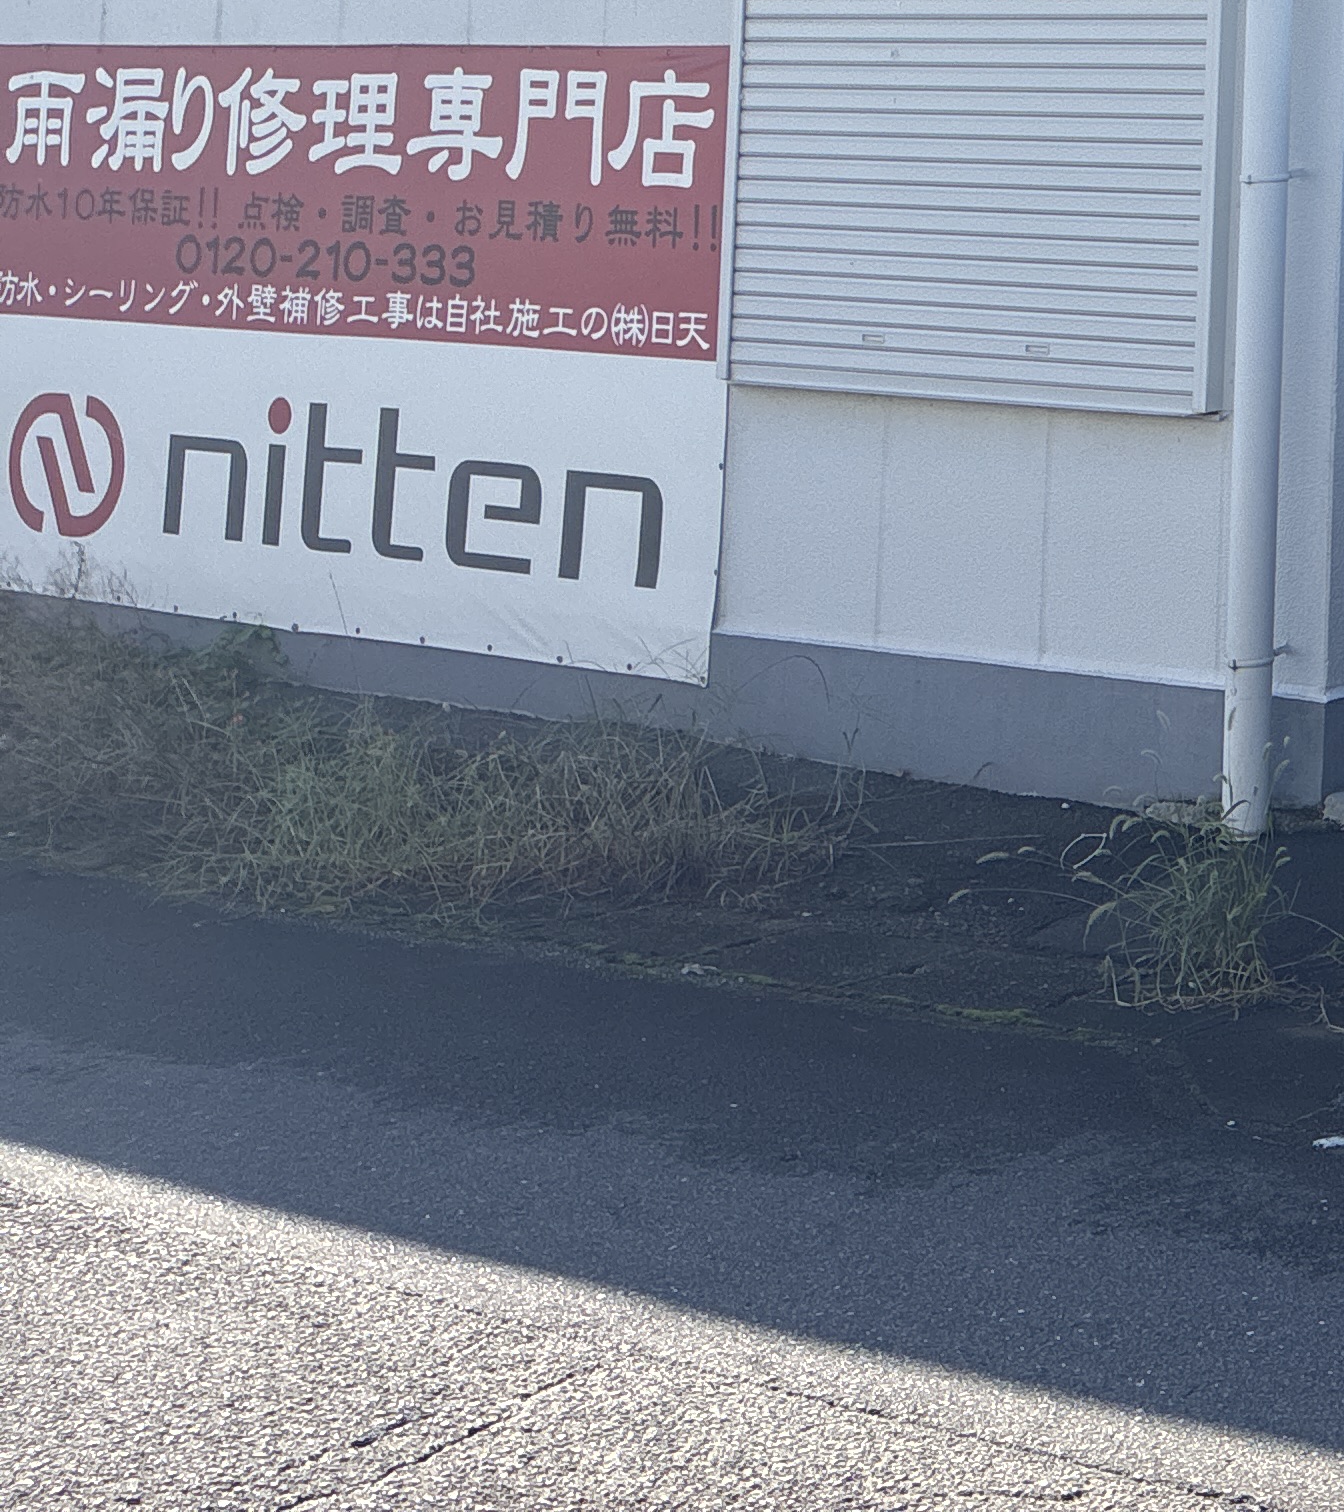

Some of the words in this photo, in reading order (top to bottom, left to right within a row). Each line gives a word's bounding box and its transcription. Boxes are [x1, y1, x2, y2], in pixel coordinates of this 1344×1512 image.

[5, 66, 717, 189] 雨漏り修理専門店
[174, 234, 476, 288] 0120-210-333
[161, 396, 664, 589] nitten
